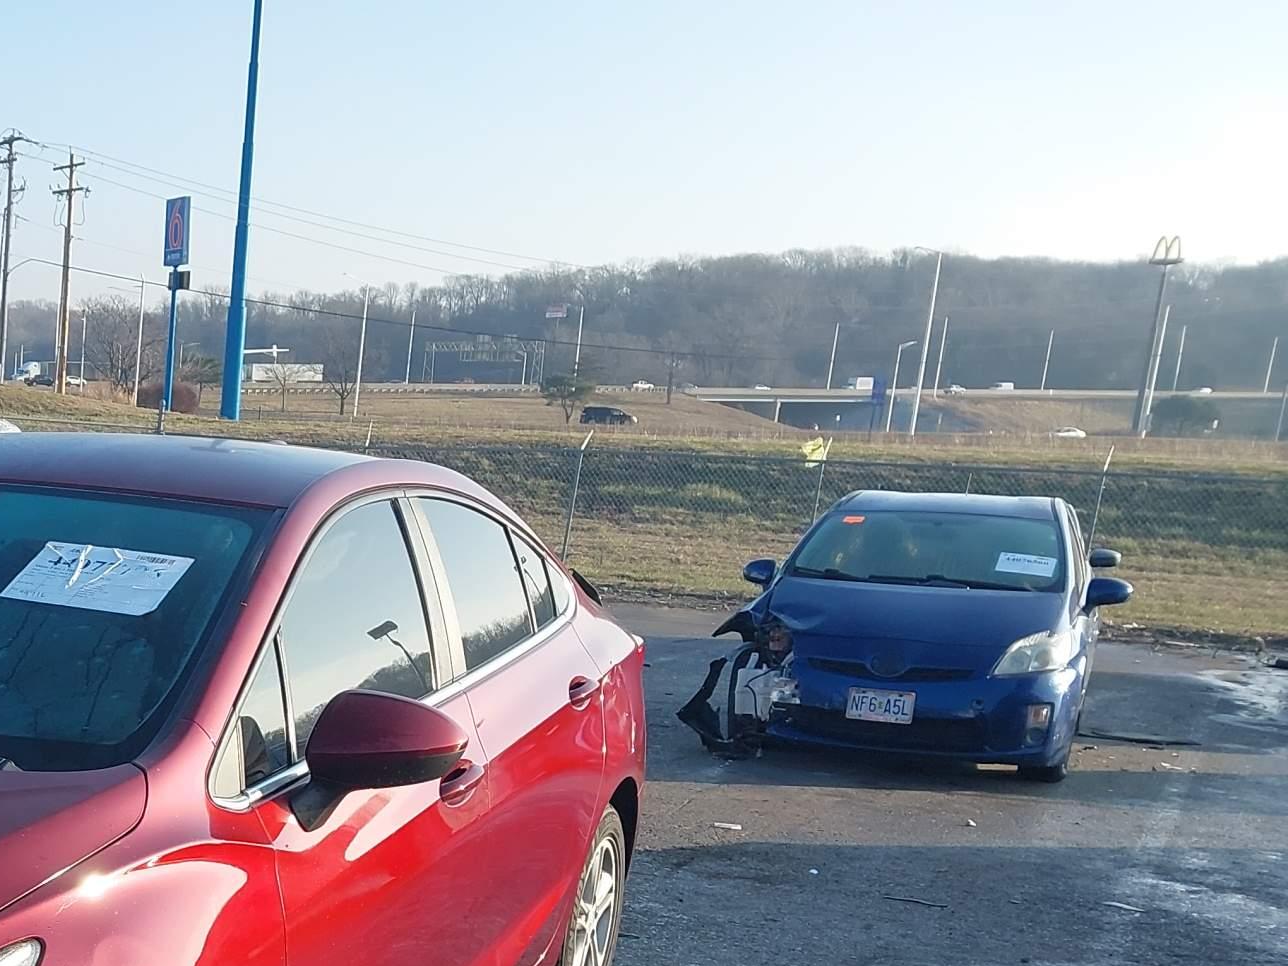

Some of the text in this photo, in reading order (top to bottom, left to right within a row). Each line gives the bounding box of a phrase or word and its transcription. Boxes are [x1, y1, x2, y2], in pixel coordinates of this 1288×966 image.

[168, 200, 184, 250] 6
[851, 695, 909, 716] NF6 A5L
